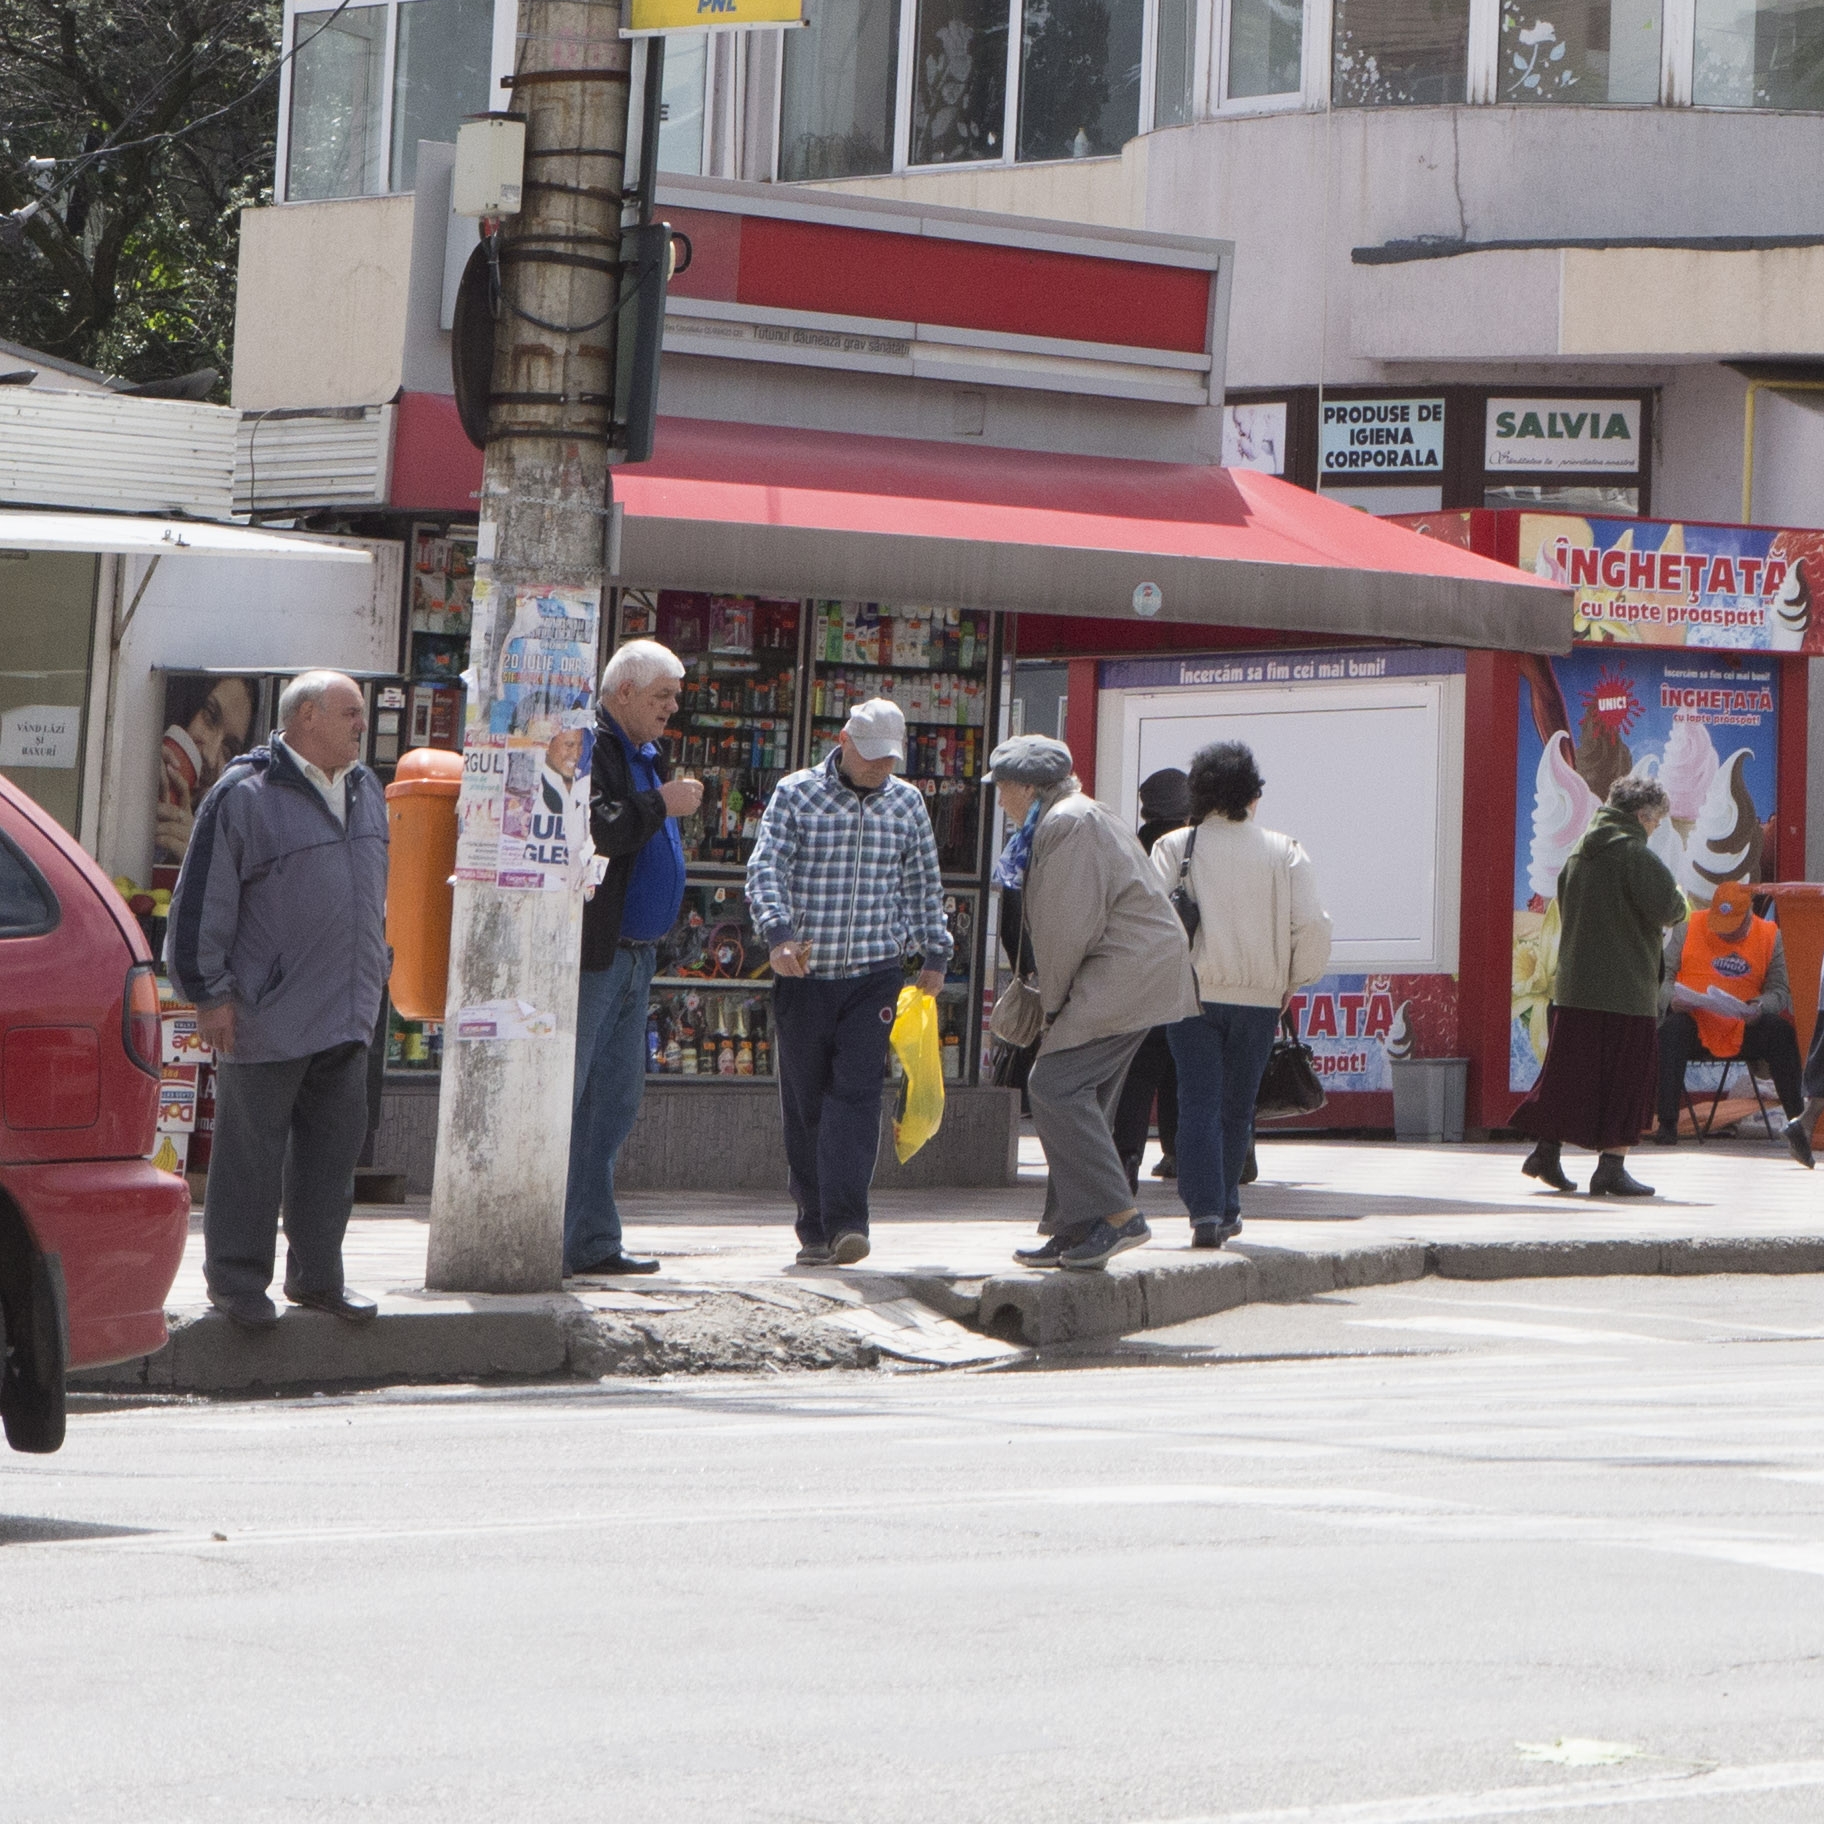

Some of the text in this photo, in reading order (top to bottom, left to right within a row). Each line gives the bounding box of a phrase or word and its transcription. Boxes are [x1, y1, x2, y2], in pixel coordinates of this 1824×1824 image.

[753, 325, 790, 344] Tutunul
[843, 337, 866, 352] grav
[1324, 404, 1442, 424] PRODUSE DE
[1496, 411, 1631, 440] SALVIA
[1350, 427, 1414, 446] IGIENA
[1325, 449, 1439, 468] CORPORALA
[1580, 600, 1765, 627] cu lapte proaspăt!
[503, 654, 519, 669] 20
[523, 654, 553, 671] IULIE
[1179, 662, 1243, 684] Încercăm
[1266, 661, 1290, 680] fim
[1293, 661, 1315, 678] cei
[1318, 659, 1345, 677] mai
[1349, 657, 1386, 677] buni!
[1598, 696, 1627, 712] UNIC!
[1673, 714, 1685, 723] cu
[1686, 713, 1712, 724] lapte
